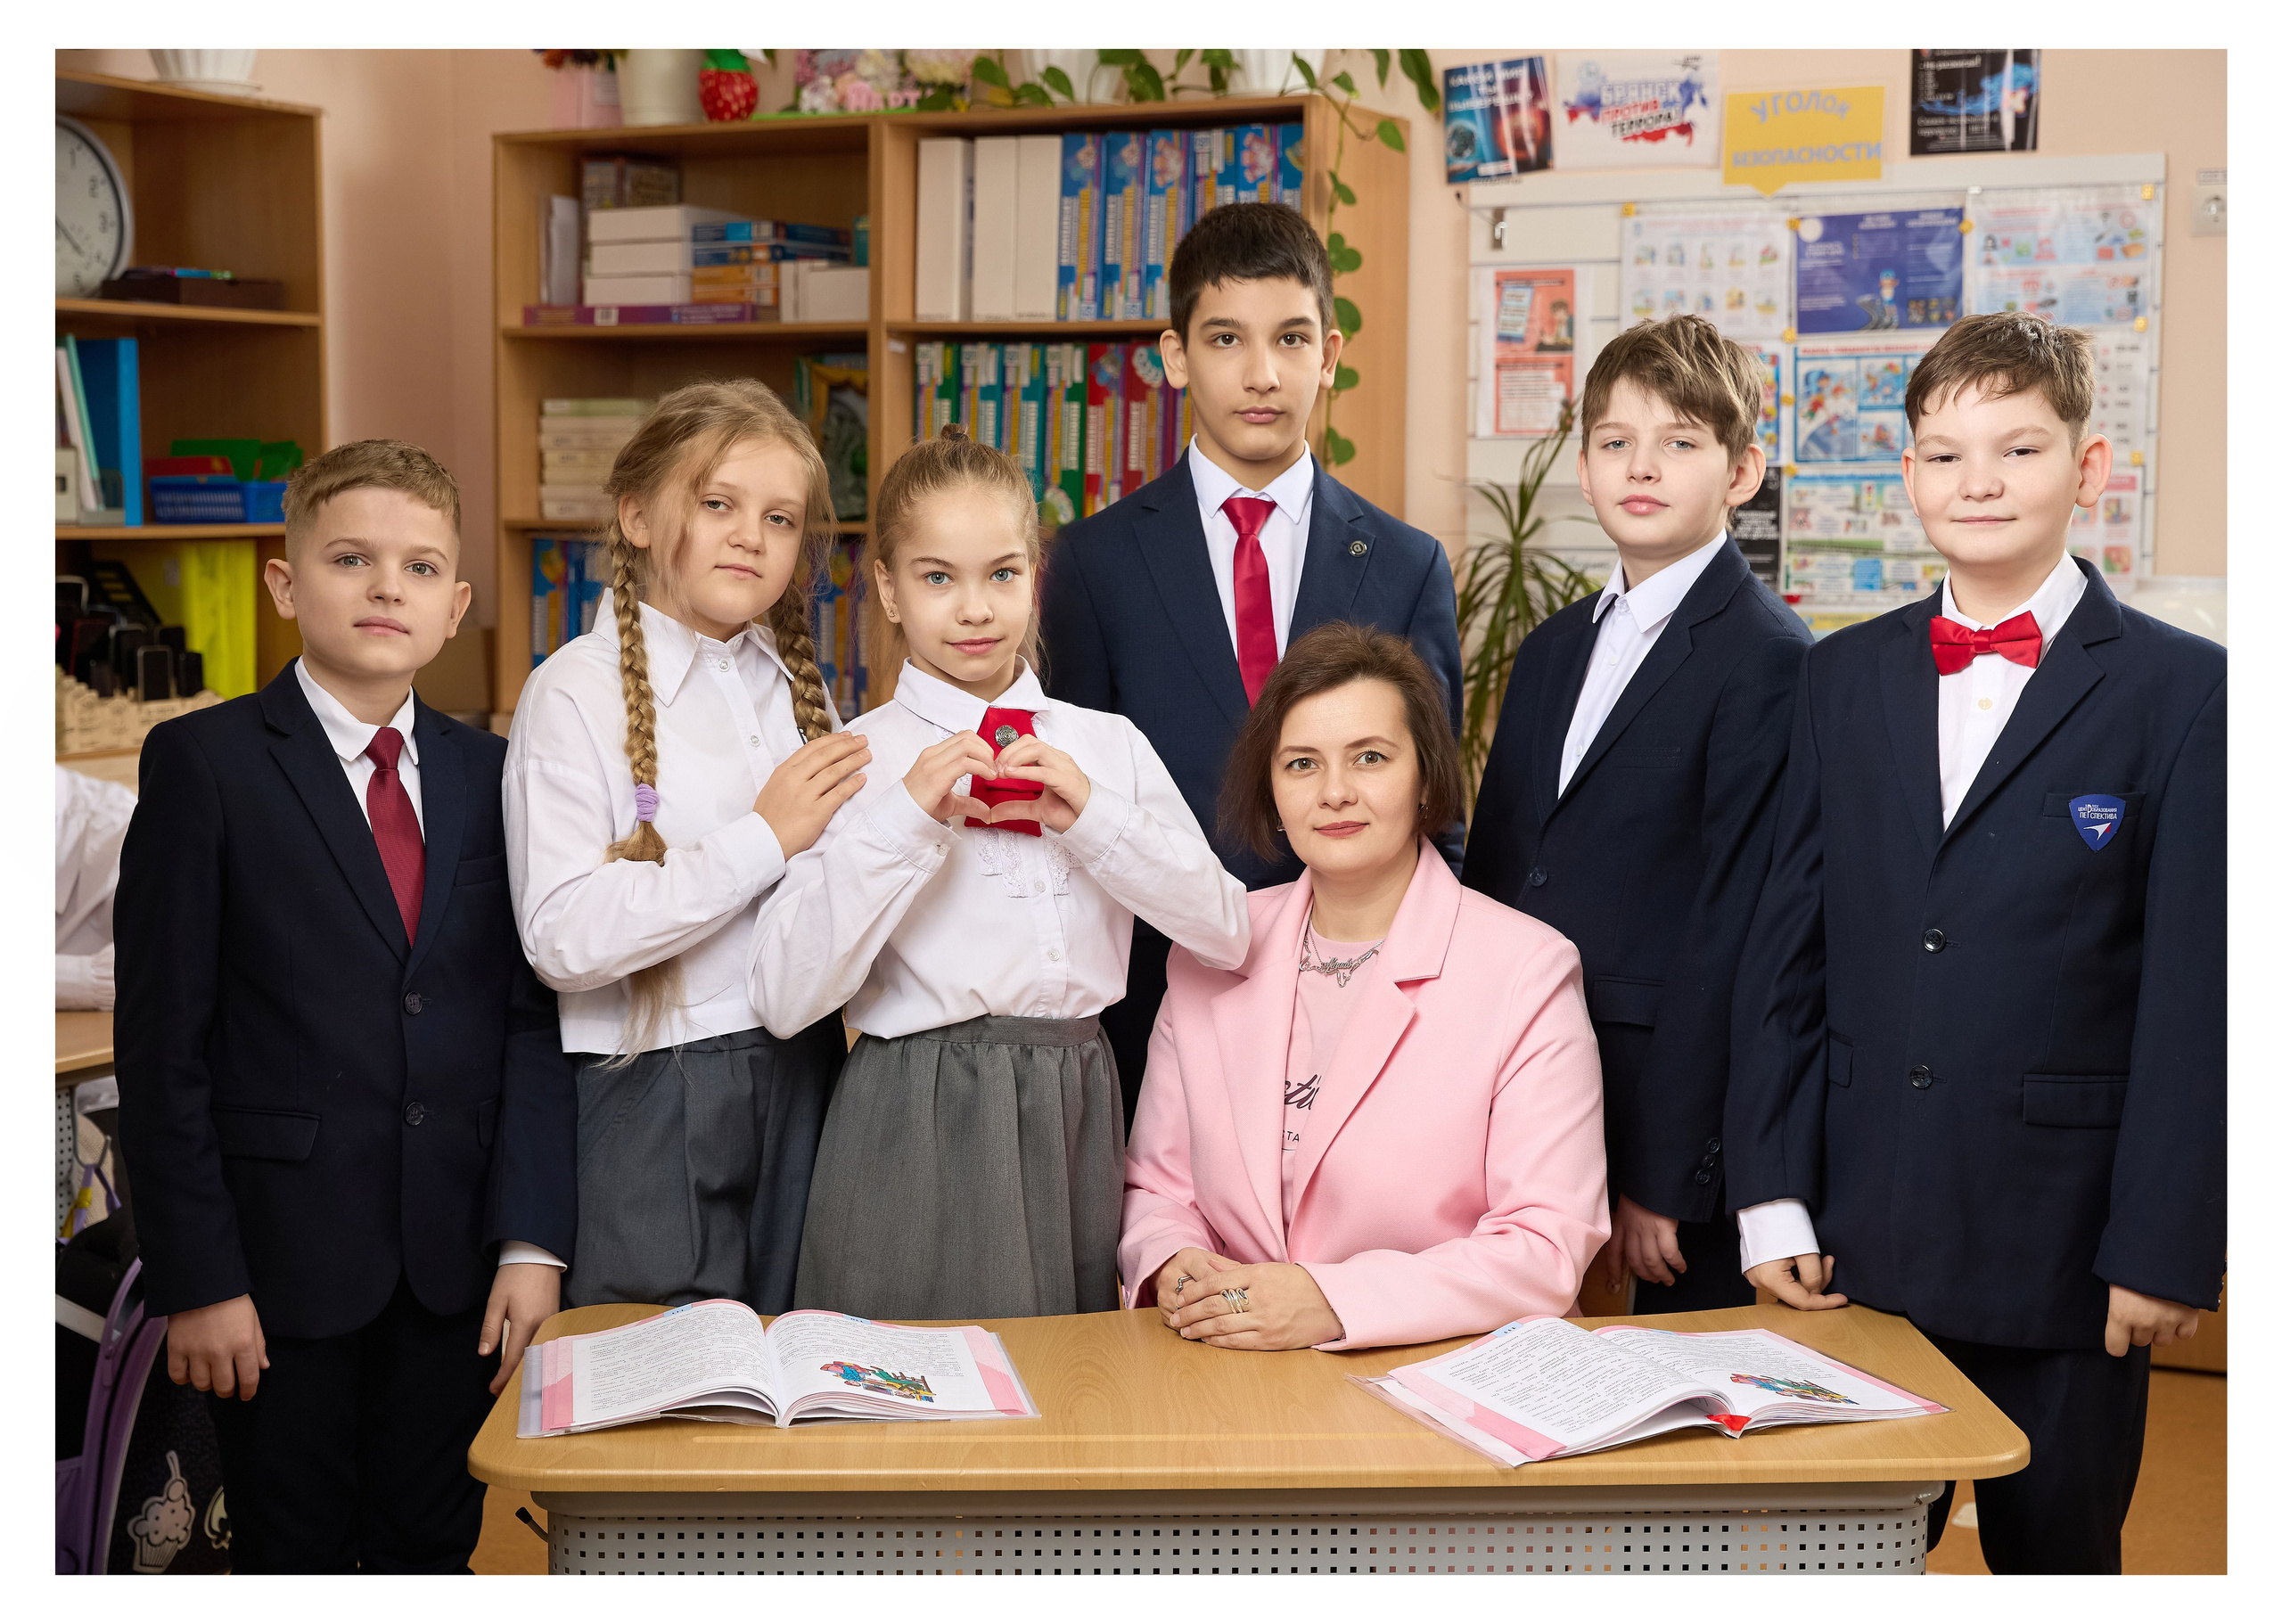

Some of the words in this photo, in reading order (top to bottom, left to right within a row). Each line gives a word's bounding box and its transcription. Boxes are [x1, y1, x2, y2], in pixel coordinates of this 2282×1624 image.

[1600, 99, 1662, 123] ПРОТИВ
[1749, 90, 1852, 124] УГОЛОК
[1732, 142, 1883, 168] БЕЗОПАСНОСТИ
[2079, 810, 2118, 820] ПЕРСПЕКТИВА
